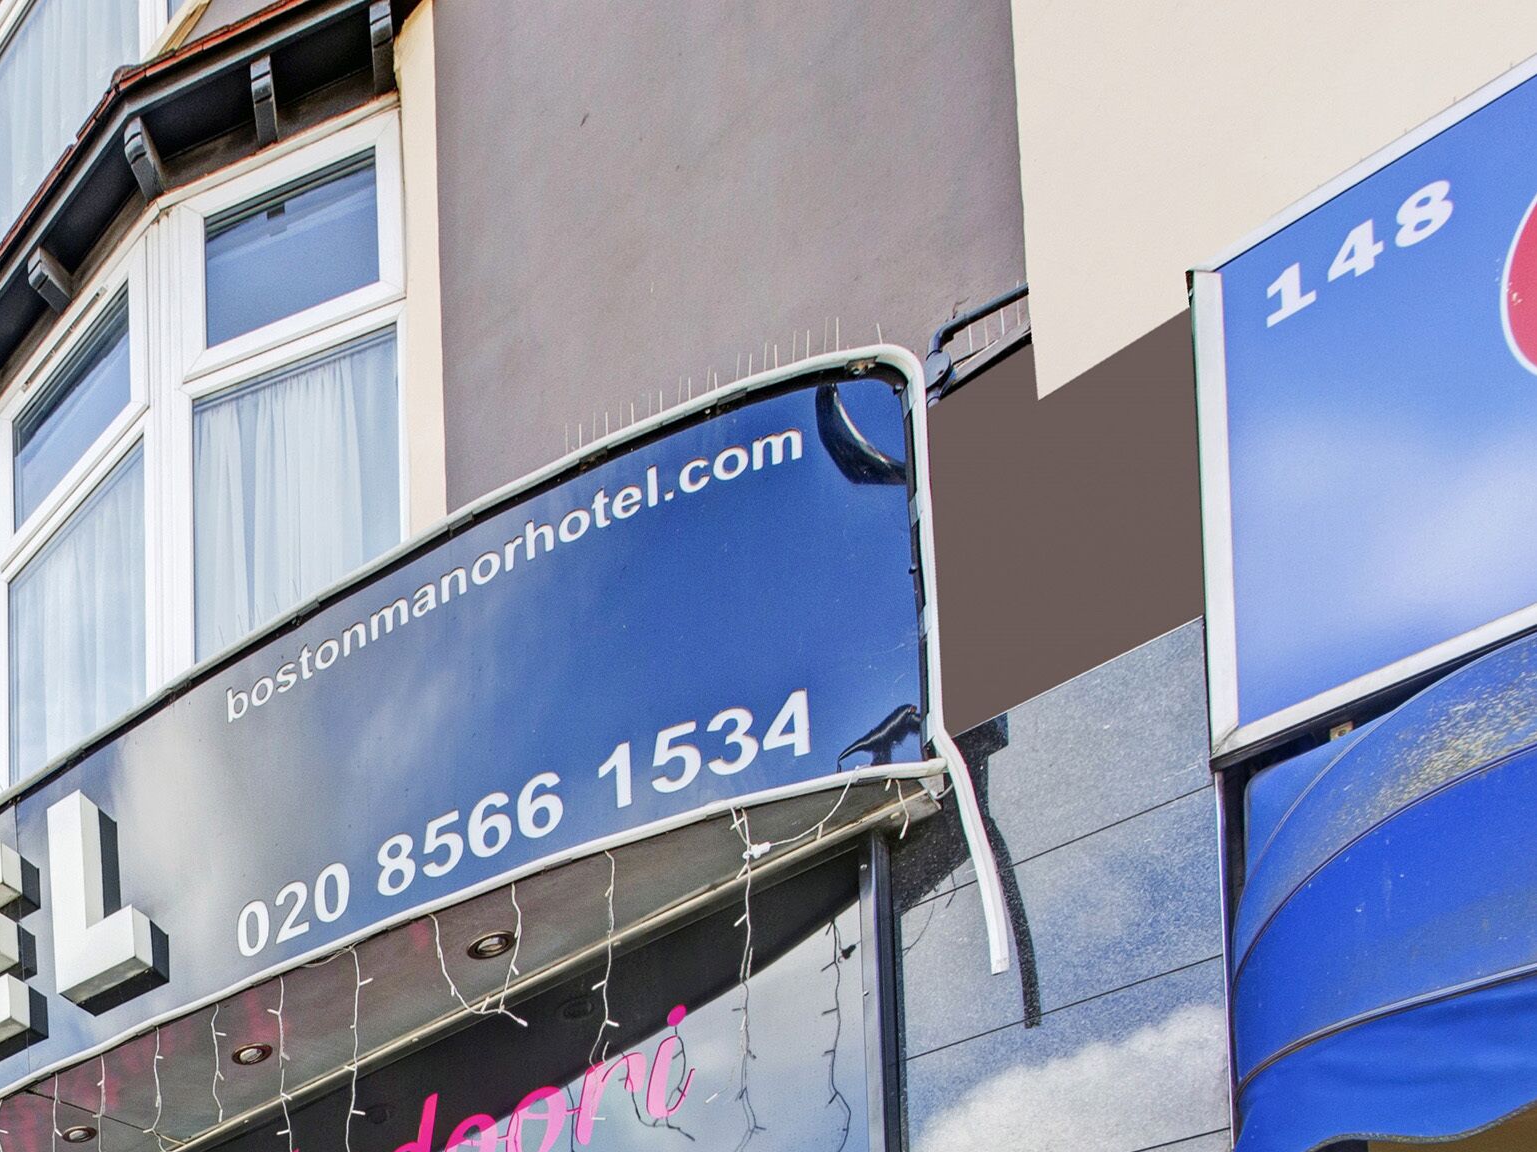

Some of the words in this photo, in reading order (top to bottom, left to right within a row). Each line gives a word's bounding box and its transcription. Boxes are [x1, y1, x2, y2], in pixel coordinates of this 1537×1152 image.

[1266, 180, 1453, 327] 148
[226, 427, 803, 724] bostonmanorhotel.com
[236, 862, 351, 958] 020
[376, 772, 564, 898] 8566
[597, 687, 811, 810] 1534
